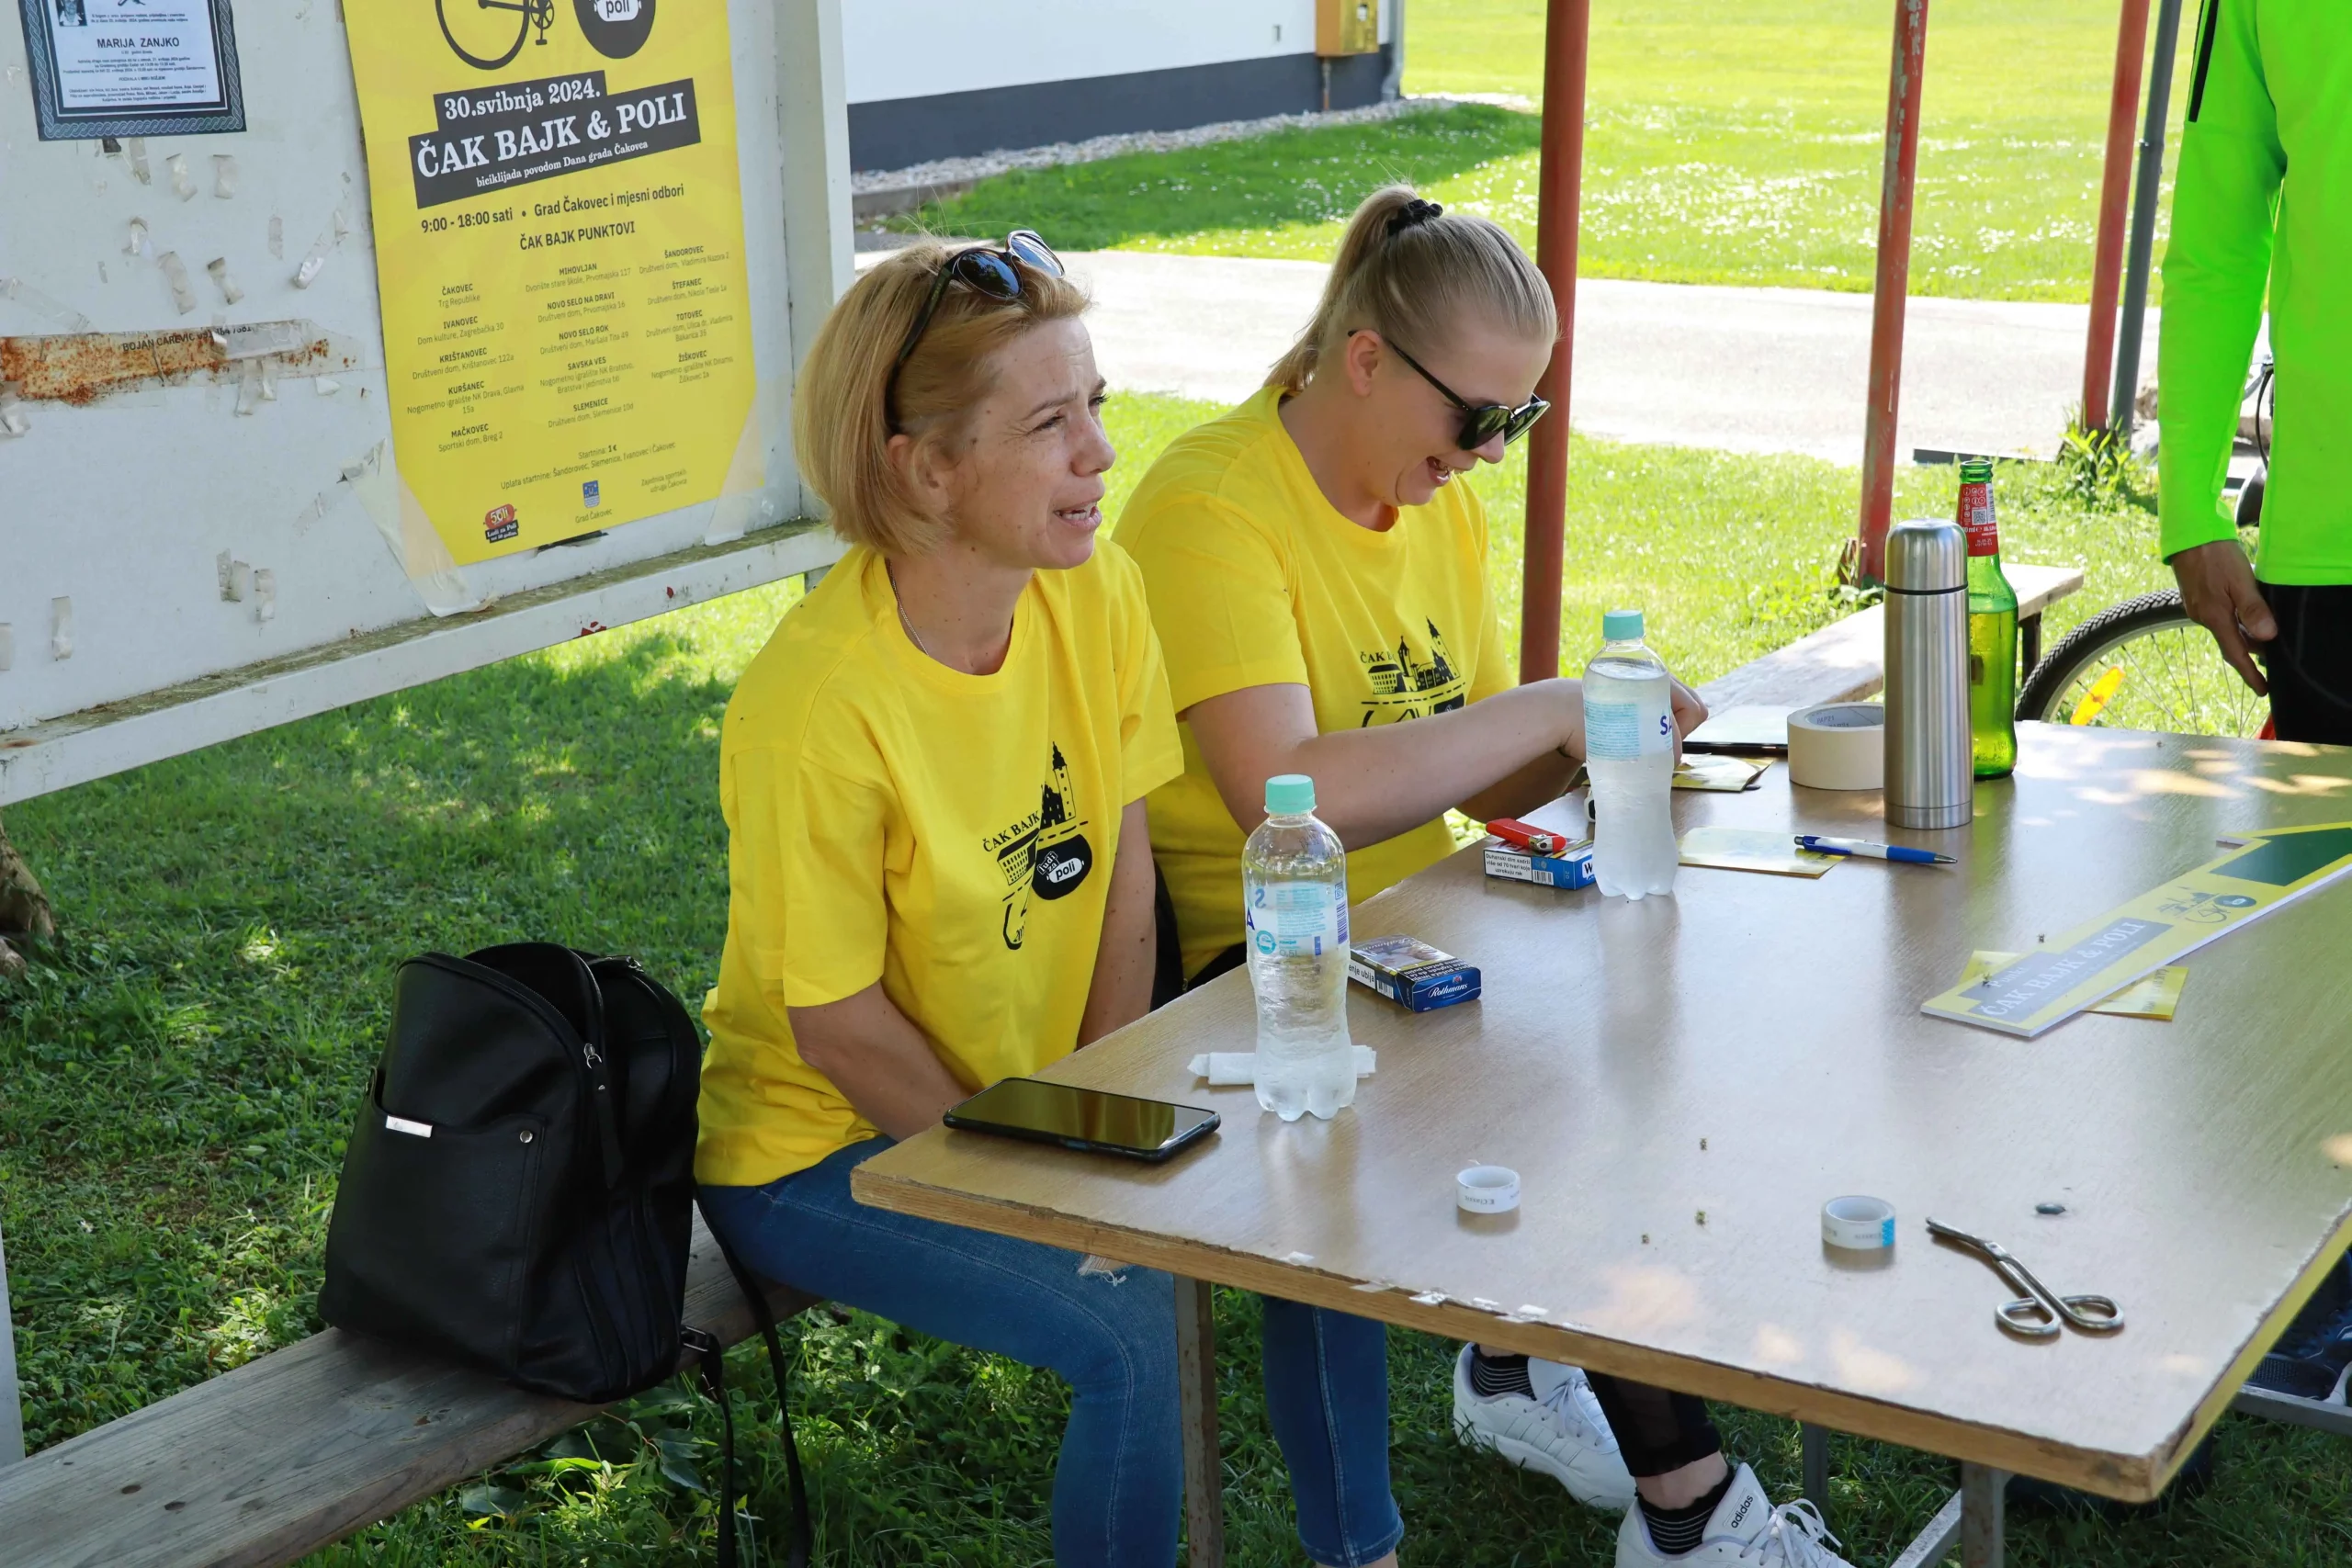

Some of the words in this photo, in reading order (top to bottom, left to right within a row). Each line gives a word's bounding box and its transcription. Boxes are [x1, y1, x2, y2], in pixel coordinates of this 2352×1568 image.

[605, 0, 629, 18] poli
[97, 38, 135, 49] MARIJA
[141, 37, 180, 48] ZANJKO
[445, 86, 544, 120] 30.svibnja
[548, 77, 601, 104] 2024.
[417, 135, 489, 178] ČAK
[494, 116, 581, 162] BAJK
[587, 110, 611, 141] &
[616, 92, 687, 134] POLI
[476, 169, 522, 187] biciklijada
[524, 159, 561, 178] povodom
[563, 153, 586, 167] Dana
[588, 148, 613, 164] grada
[614, 141, 649, 156] Čakovca
[421, 217, 447, 233] 9:00
[458, 211, 490, 228] 18:00
[492, 208, 514, 223] sati
[534, 199, 560, 217] Grad
[563, 195, 609, 213] Čakovec
[611, 193, 615, 206] i
[616, 187, 650, 208] mjesni
[652, 184, 684, 199] odbori
[520, 231, 543, 251] ČAK
[545, 229, 575, 247] BAJK
[578, 220, 636, 242] PUNKTOVI
[664, 245, 704, 259] ŠANDOROVEC
[559, 263, 597, 276] MIHOVLJAN
[442, 283, 473, 296] ČAKOVEC
[551, 279, 566, 288] stare
[673, 277, 702, 289] ŠTEFANEC
[438, 299, 449, 309] Trg
[450, 294, 481, 306] Republike
[548, 299, 565, 310] NOVO
[567, 297, 583, 307] SELO
[584, 295, 594, 303] NA
[594, 292, 615, 302] DRAVI
[443, 315, 478, 329] IVANOVEC
[676, 310, 703, 321] TOTOVEC
[417, 336, 433, 345] Dom
[435, 332, 458, 343] kulture,
[459, 325, 494, 338] Zagrebačka
[496, 322, 504, 331] 30
[559, 331, 577, 340] NOVO
[578, 327, 594, 337] SELO
[595, 324, 609, 333] ROK
[122, 339, 154, 352] BOJAN
[439, 346, 488, 364] KRIŠTANOVEC
[568, 359, 593, 370] SAVSKA
[594, 355, 606, 365] VES
[678, 349, 707, 363] ŽIŠKOVEC
[412, 368, 444, 379] Društveni
[462, 356, 497, 371] Krištanovec
[499, 353, 514, 363] 122a
[448, 380, 485, 395] KURŠANEC
[407, 400, 446, 415] Nogometno
[472, 392, 481, 401] NK
[503, 384, 525, 395] Glavna
[573, 397, 608, 412] SLEMENICE
[462, 405, 475, 414] 15a
[451, 423, 489, 438] MAČKOVEC
[438, 441, 465, 453] Sportski
[482, 432, 498, 443] Breg
[499, 431, 503, 439] 2
[578, 446, 607, 459] Startnina:
[501, 479, 522, 491] Uplata
[523, 471, 552, 487] startnine:
[652, 441, 676, 453] Čakovec
[575, 513, 589, 524] Grad
[590, 508, 613, 521] Čakovec
[1360, 650, 1385, 664] ČAK
[982, 829, 1012, 853] ČAK
[1012, 810, 1041, 836] BAJK
[1038, 852, 1057, 874] ludi
[1485, 853, 1507, 863] Duhanski
[1055, 861, 1076, 881] poli
[1348, 964, 1361, 975] enje
[1361, 969, 1374, 982] ubija
[1979, 988, 2036, 1016] ČAK
[2029, 956, 2082, 990] BAJK
[2081, 947, 2103, 960] &
[2099, 921, 2148, 949] POLI
[1428, 983, 1468, 998] Rothmans
[1730, 1495, 1754, 1529] adidas
